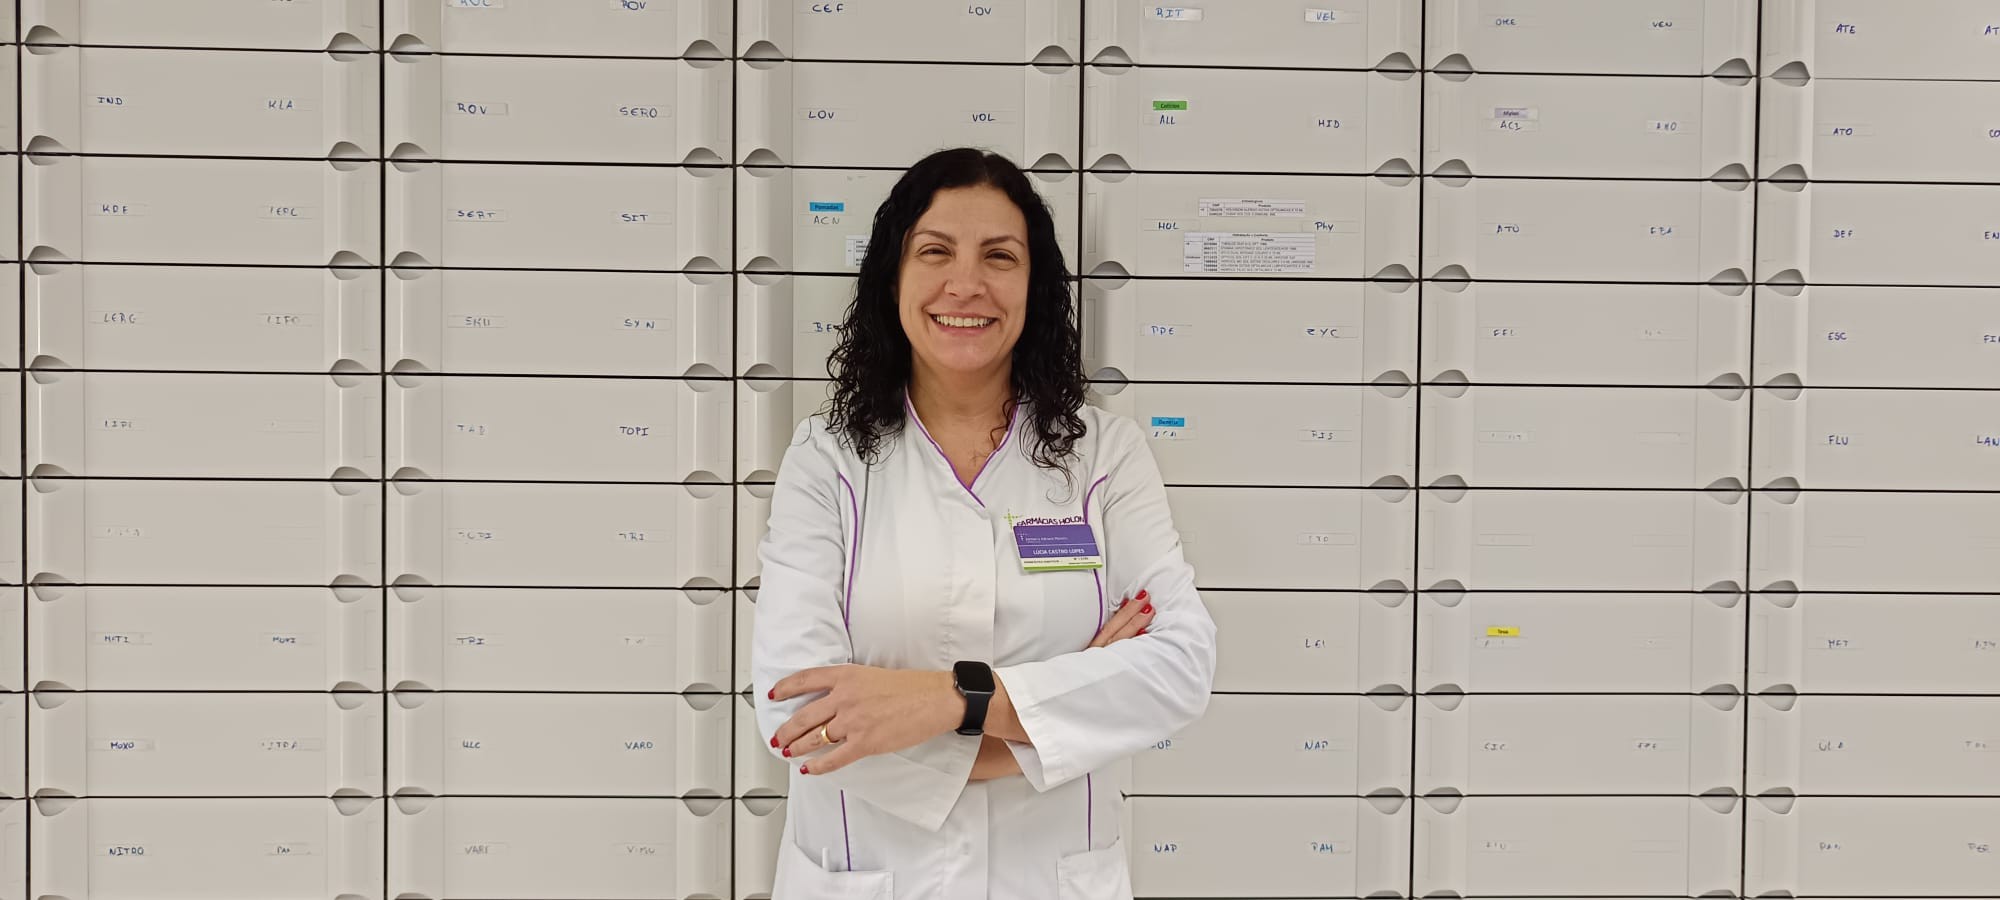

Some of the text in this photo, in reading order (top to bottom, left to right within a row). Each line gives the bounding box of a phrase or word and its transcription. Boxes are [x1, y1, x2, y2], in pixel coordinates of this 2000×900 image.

[812, 4, 843, 13] CEF
[969, 5, 991, 16] LOV
[1317, 11, 1335, 20] VEL
[1836, 24, 1855, 34] ATE
[269, 100, 292, 110] KLA
[457, 103, 486, 114] ROV
[620, 107, 657, 118] SERO
[809, 110, 834, 119] LOV
[973, 114, 995, 122] VOL
[1319, 120, 1339, 128] HID
[622, 214, 648, 222] SIT
[1828, 332, 1846, 340] ESC
[620, 426, 648, 436] TOPI
[1829, 435, 1848, 445] FLU
[110, 847, 144, 856] NITRO
